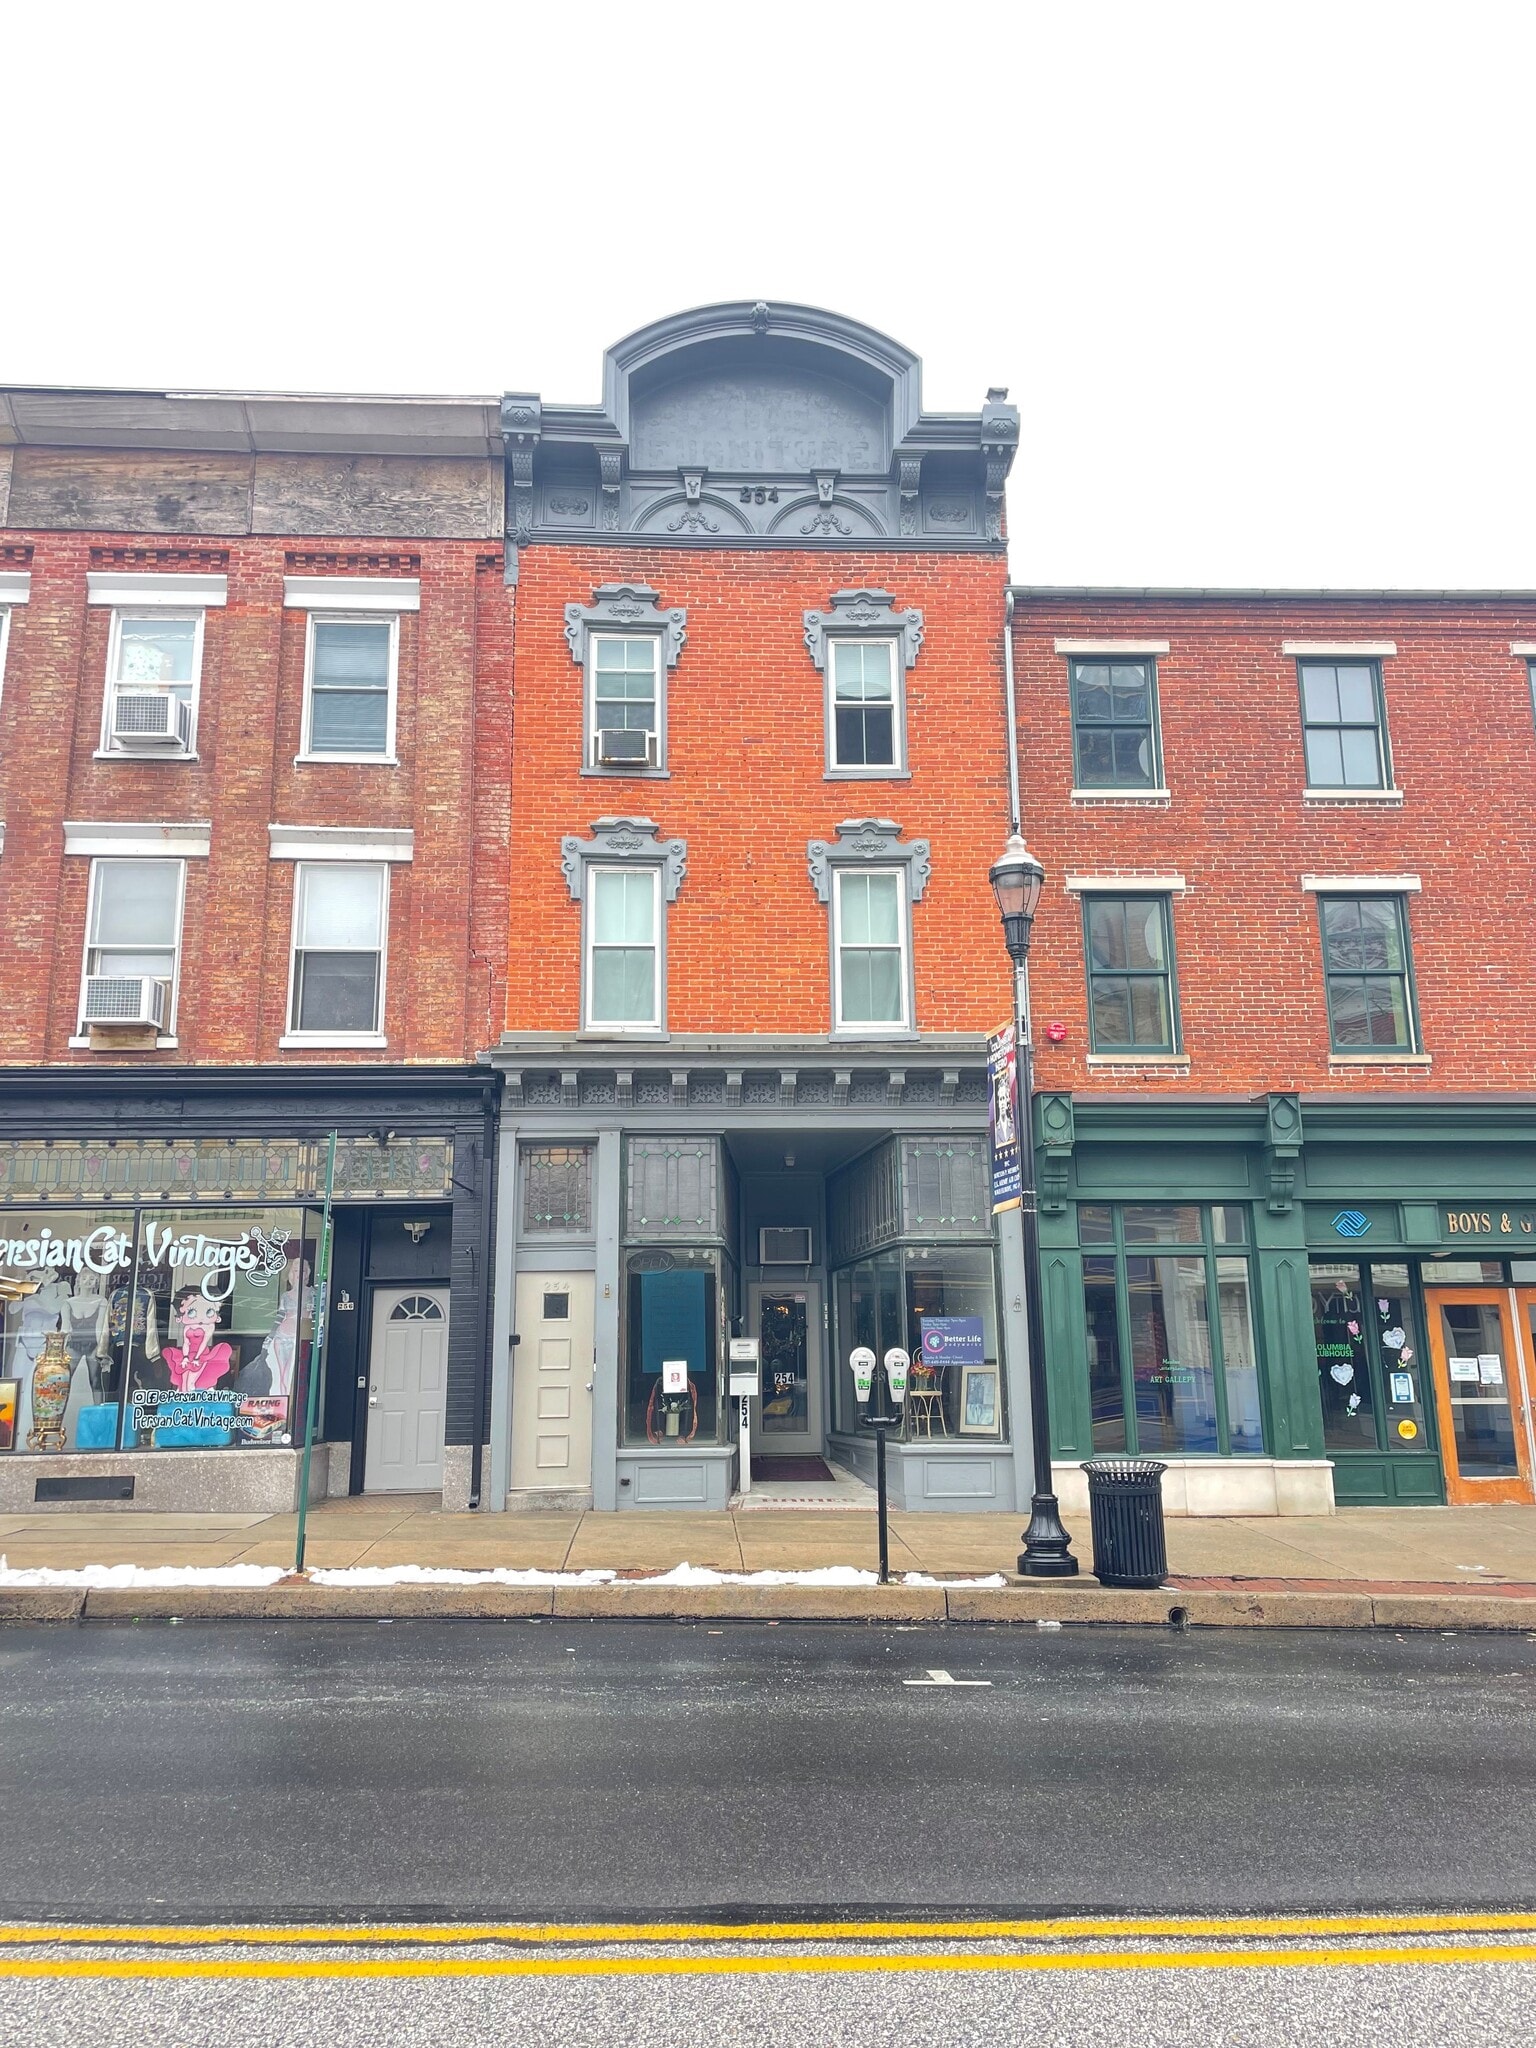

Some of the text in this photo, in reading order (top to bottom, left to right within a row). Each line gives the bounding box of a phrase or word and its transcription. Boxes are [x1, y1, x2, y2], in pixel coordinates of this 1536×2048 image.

[739, 485, 779, 505] 254
[1446, 1212, 1492, 1233] BOYS
[1500, 1212, 1513, 1233] &
[0, 1228, 84, 1274] ersian
[145, 1221, 257, 1302] Vintage
[630, 1257, 670, 1268] OPEN
[544, 1280, 570, 1291] 254
[1315, 1343, 1352, 1351] OLUMBIA
[1315, 1350, 1355, 1358] LUBHOUSE
[775, 1373, 795, 1384] 254
[1150, 1375, 1163, 1384] ART
[159, 1389, 249, 1408] @PersianCatVintage
[247, 1399, 281, 1408] RACING
[741, 1395, 749, 1429] 254
[241, 1438, 272, 1446] Budweiser
